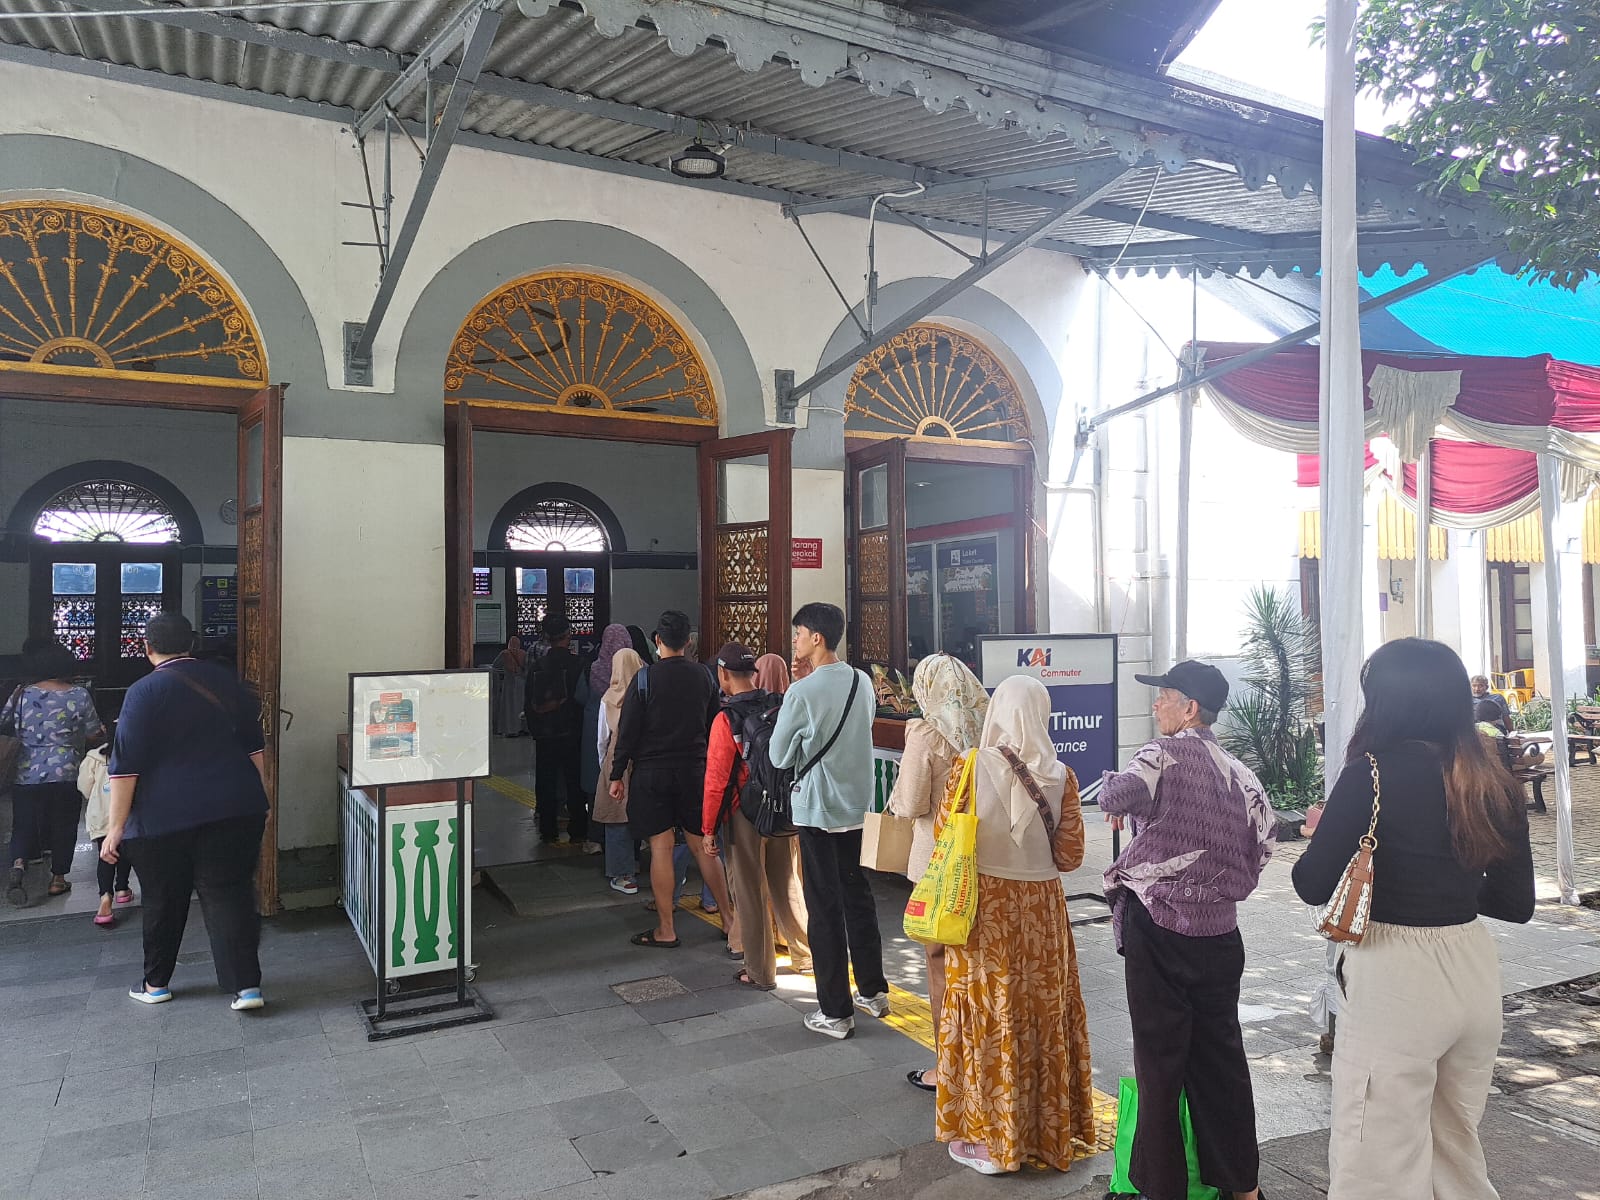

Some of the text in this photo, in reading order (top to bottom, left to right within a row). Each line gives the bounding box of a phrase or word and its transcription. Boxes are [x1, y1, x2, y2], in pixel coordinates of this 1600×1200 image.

[792, 550, 817, 558] erokok
[1017, 648, 1052, 667] KAI
[1040, 669, 1082, 678] Commuter
[1050, 711, 1103, 731] Timur
